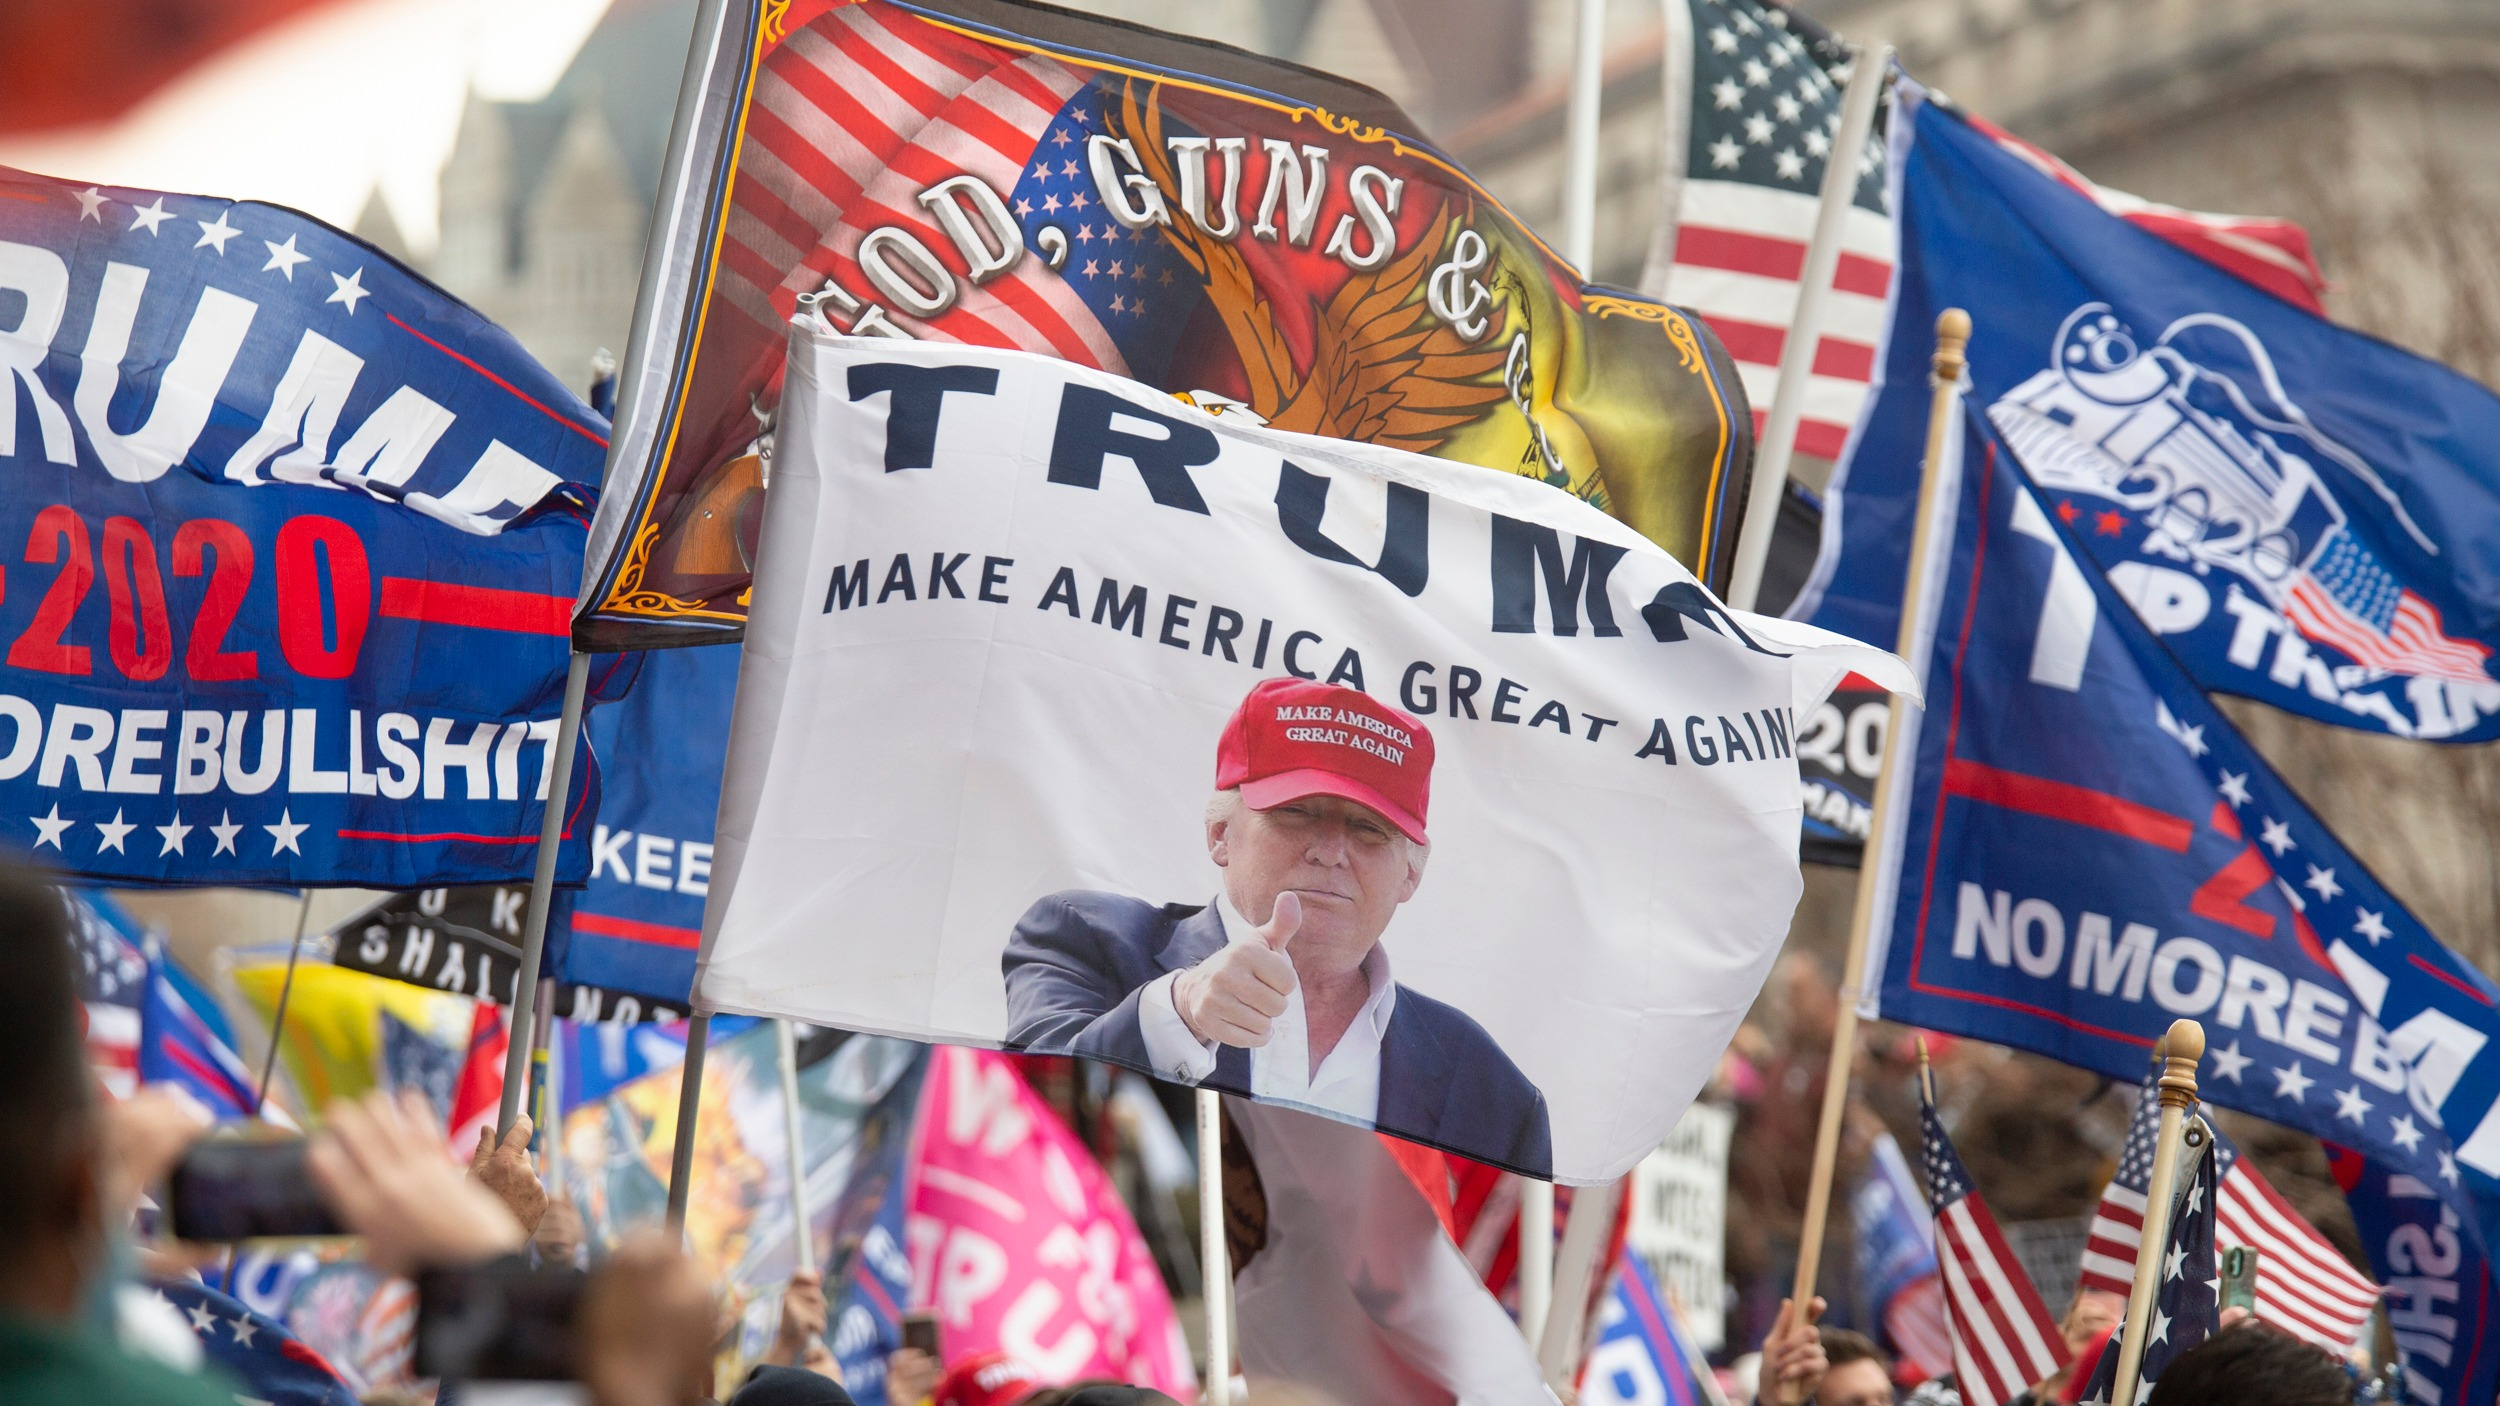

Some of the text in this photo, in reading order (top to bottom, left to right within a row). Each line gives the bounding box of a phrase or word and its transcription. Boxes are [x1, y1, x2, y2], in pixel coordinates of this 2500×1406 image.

[1087, 133, 1403, 277] GUNS
[1427, 229, 1491, 342] &
[6, 504, 371, 682] 2020
[823, 551, 1015, 614] MAKE
[1037, 565, 1367, 694] AMERICA
[1401, 660, 1619, 743] GREAT
[174, 708, 561, 801] BULLSHIT
[1276, 706, 1414, 749] MAKE AMERICA
[1285, 727, 1405, 766] GREAT AGAIN
[1952, 881, 2065, 979] NO
[2070, 910, 2349, 1066] MORE
